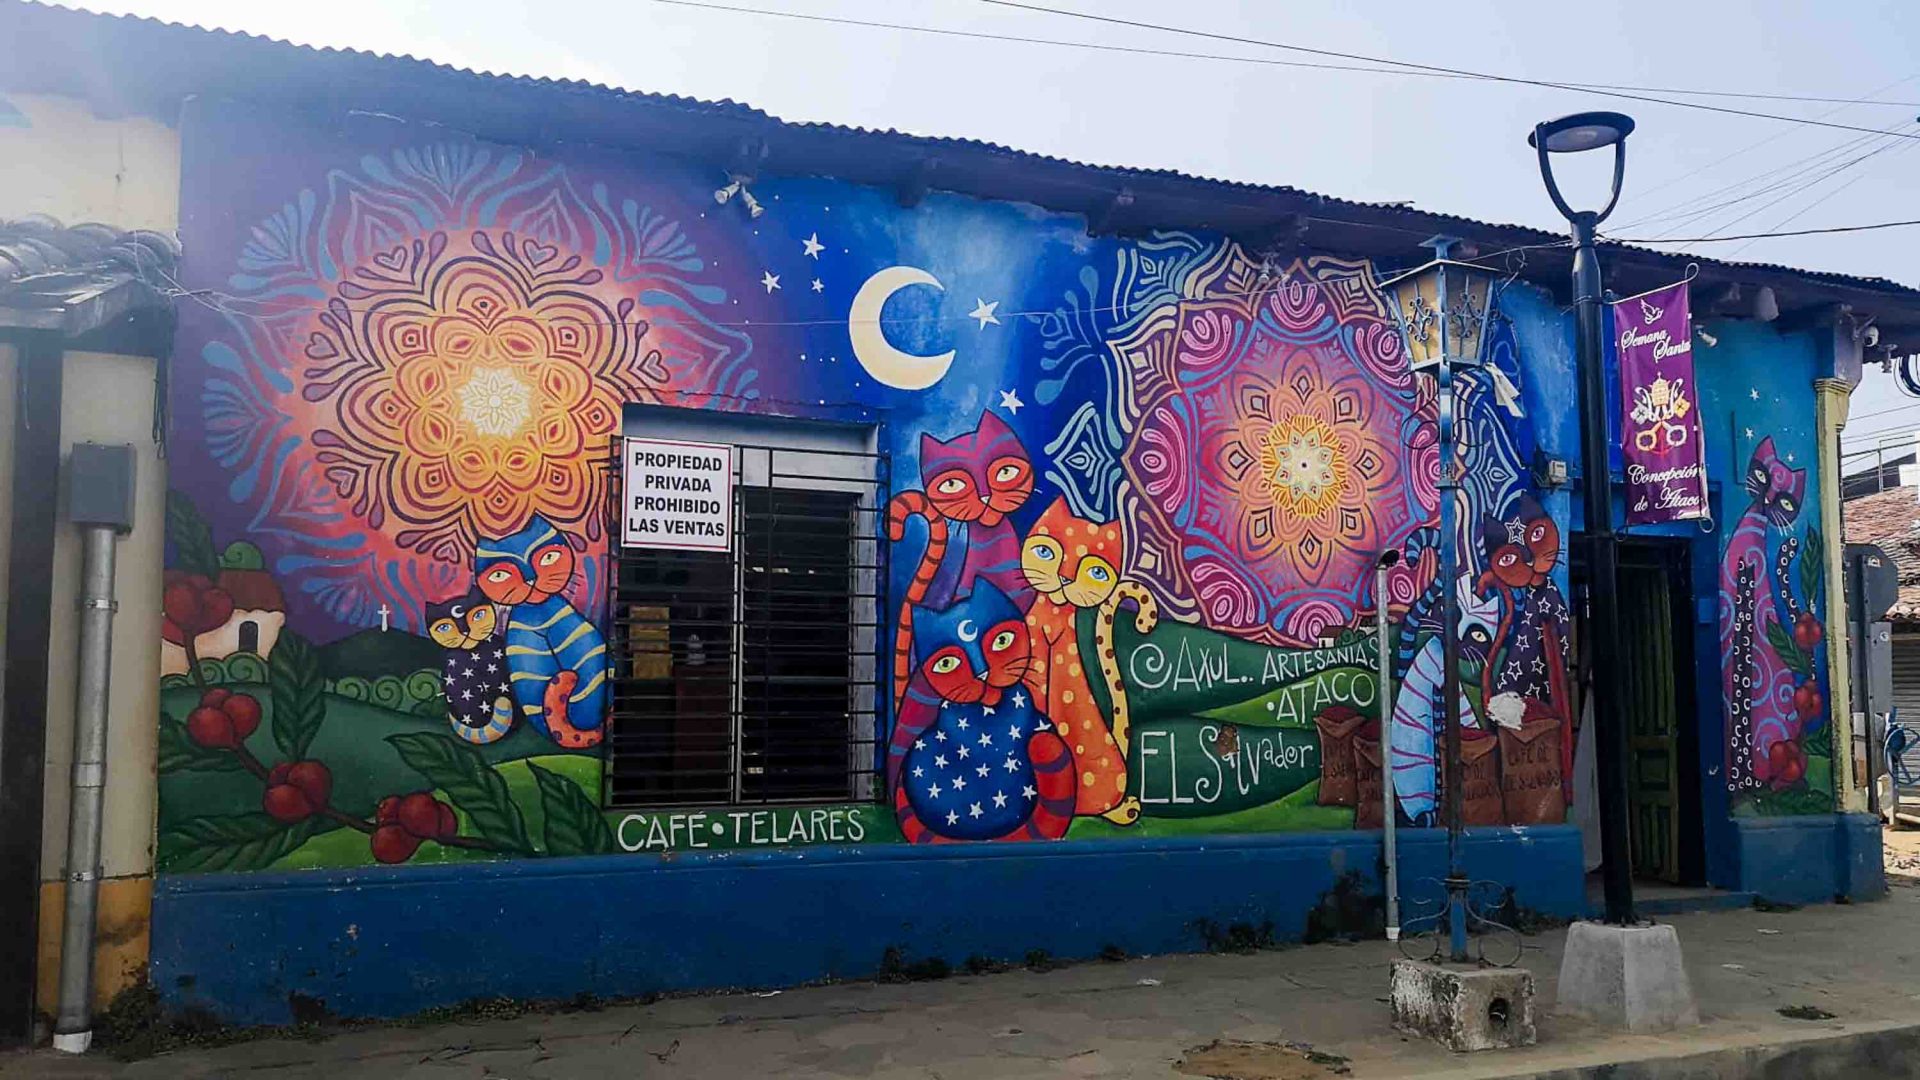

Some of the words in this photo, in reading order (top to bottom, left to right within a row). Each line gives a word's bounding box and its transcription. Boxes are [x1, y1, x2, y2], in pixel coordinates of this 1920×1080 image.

[1621, 326, 1668, 353] Semana
[1653, 336, 1692, 363] Santa
[634, 452, 722, 472] PROPIEDAD
[645, 475, 712, 493] PRIVADA
[634, 496, 721, 515] PROHIBIDO
[1634, 495, 1649, 512] de
[1655, 487, 1700, 509] Ataco
[629, 518, 659, 534] LAS
[664, 519, 725, 537] VENTAS
[1140, 731, 1194, 804] EL
[617, 811, 709, 852] CAFÉ
[727, 809, 865, 844] TELARES
